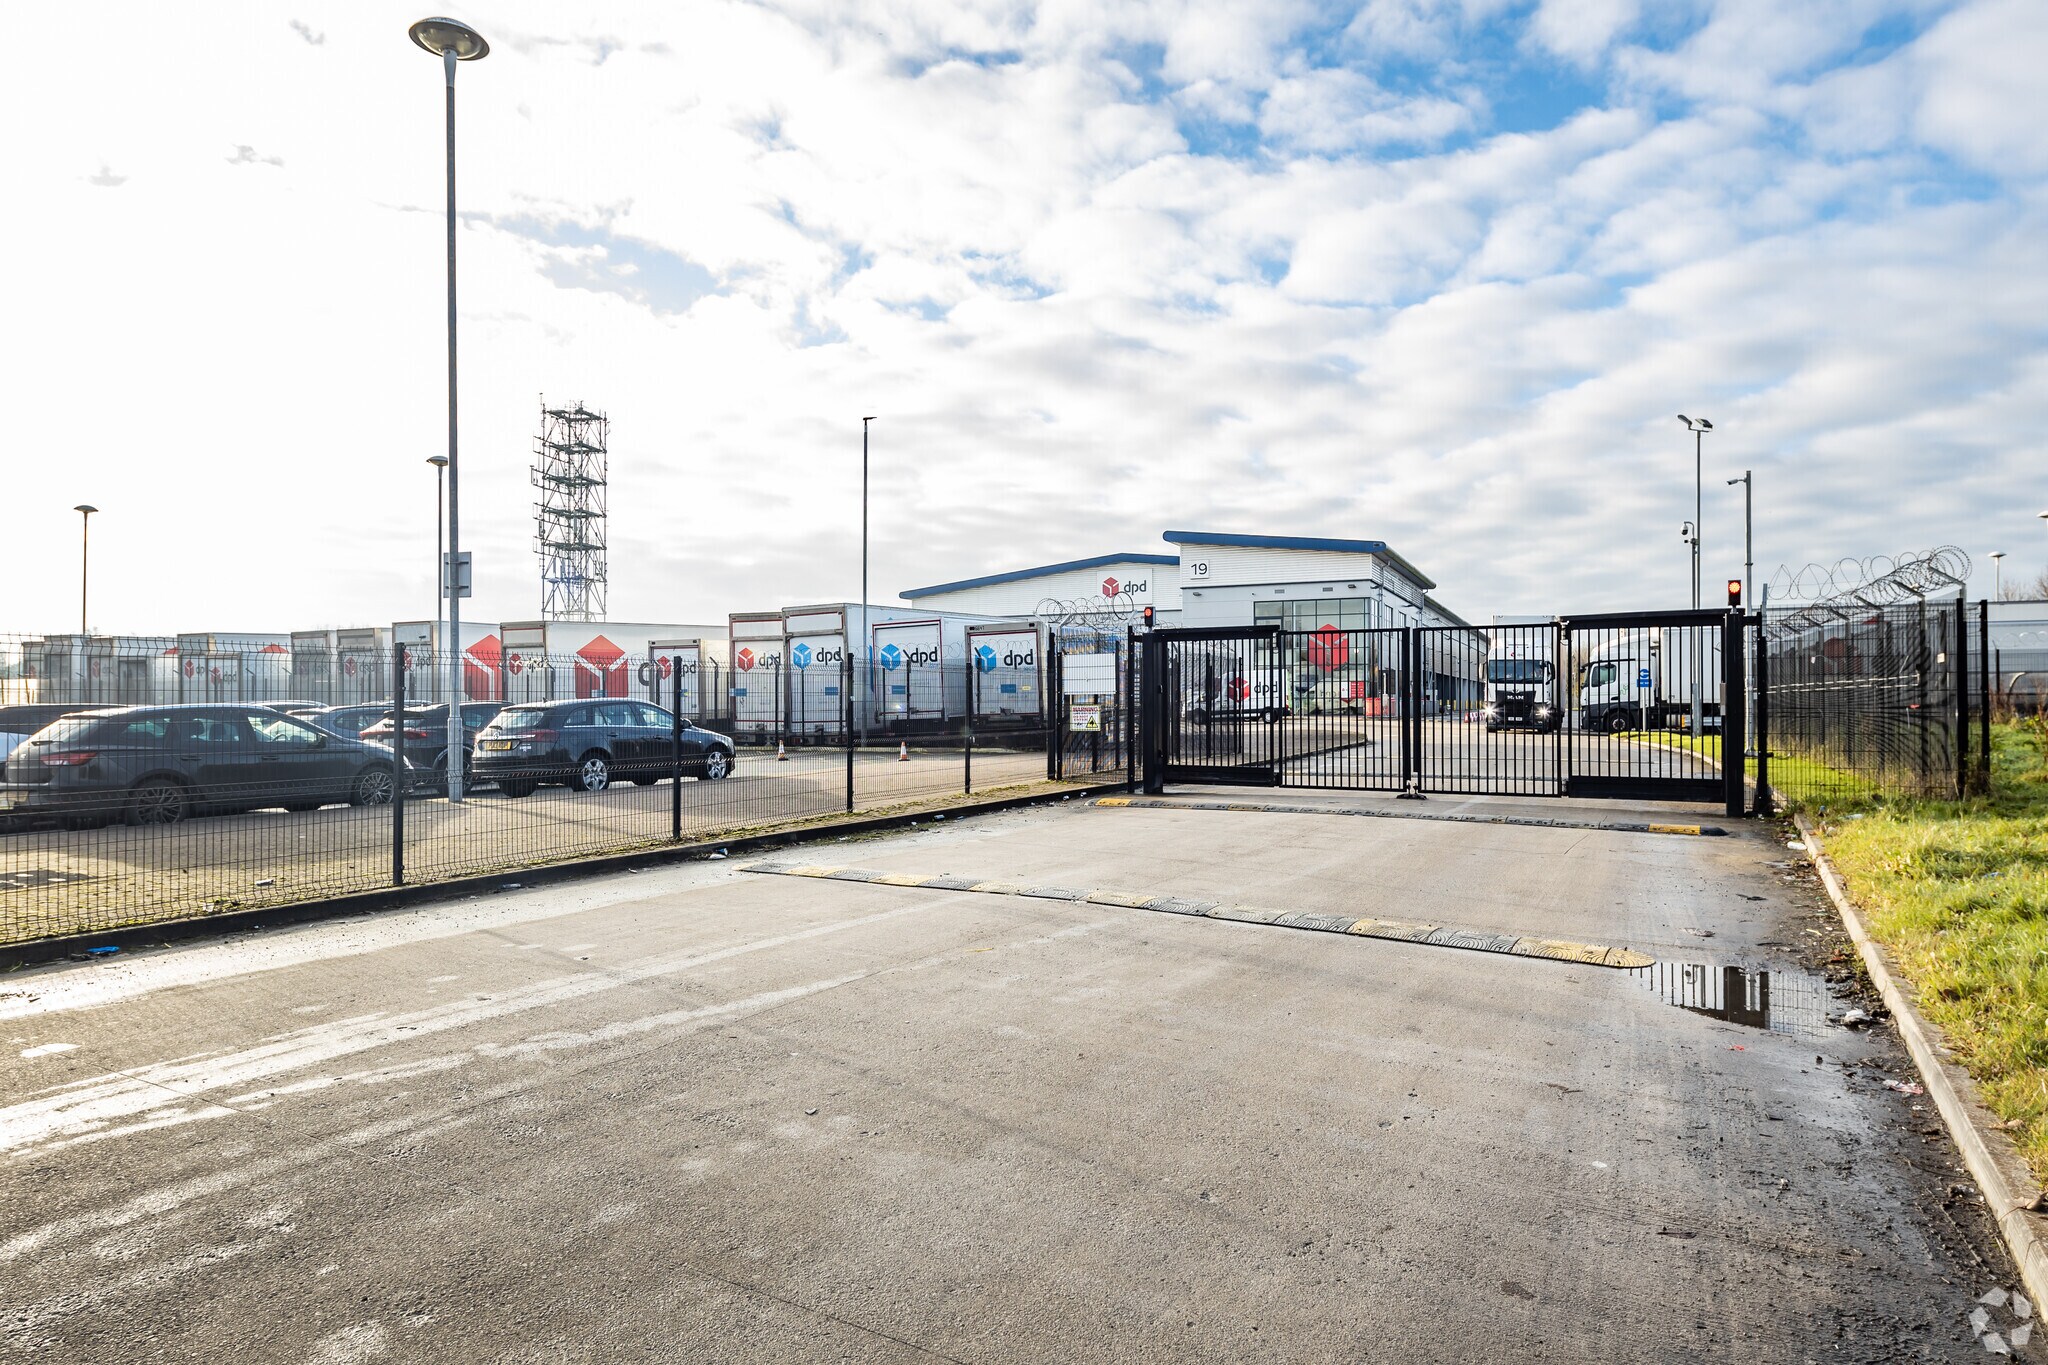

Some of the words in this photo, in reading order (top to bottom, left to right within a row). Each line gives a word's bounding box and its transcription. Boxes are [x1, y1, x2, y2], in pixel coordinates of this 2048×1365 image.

[1190, 562, 1208, 576] 19
[1123, 580, 1147, 596] dpd
[758, 652, 781, 669] dpd
[816, 646, 842, 666] dpd
[910, 646, 938, 667] dpd
[1003, 648, 1034, 670] dpd
[1253, 681, 1278, 694] dpd
